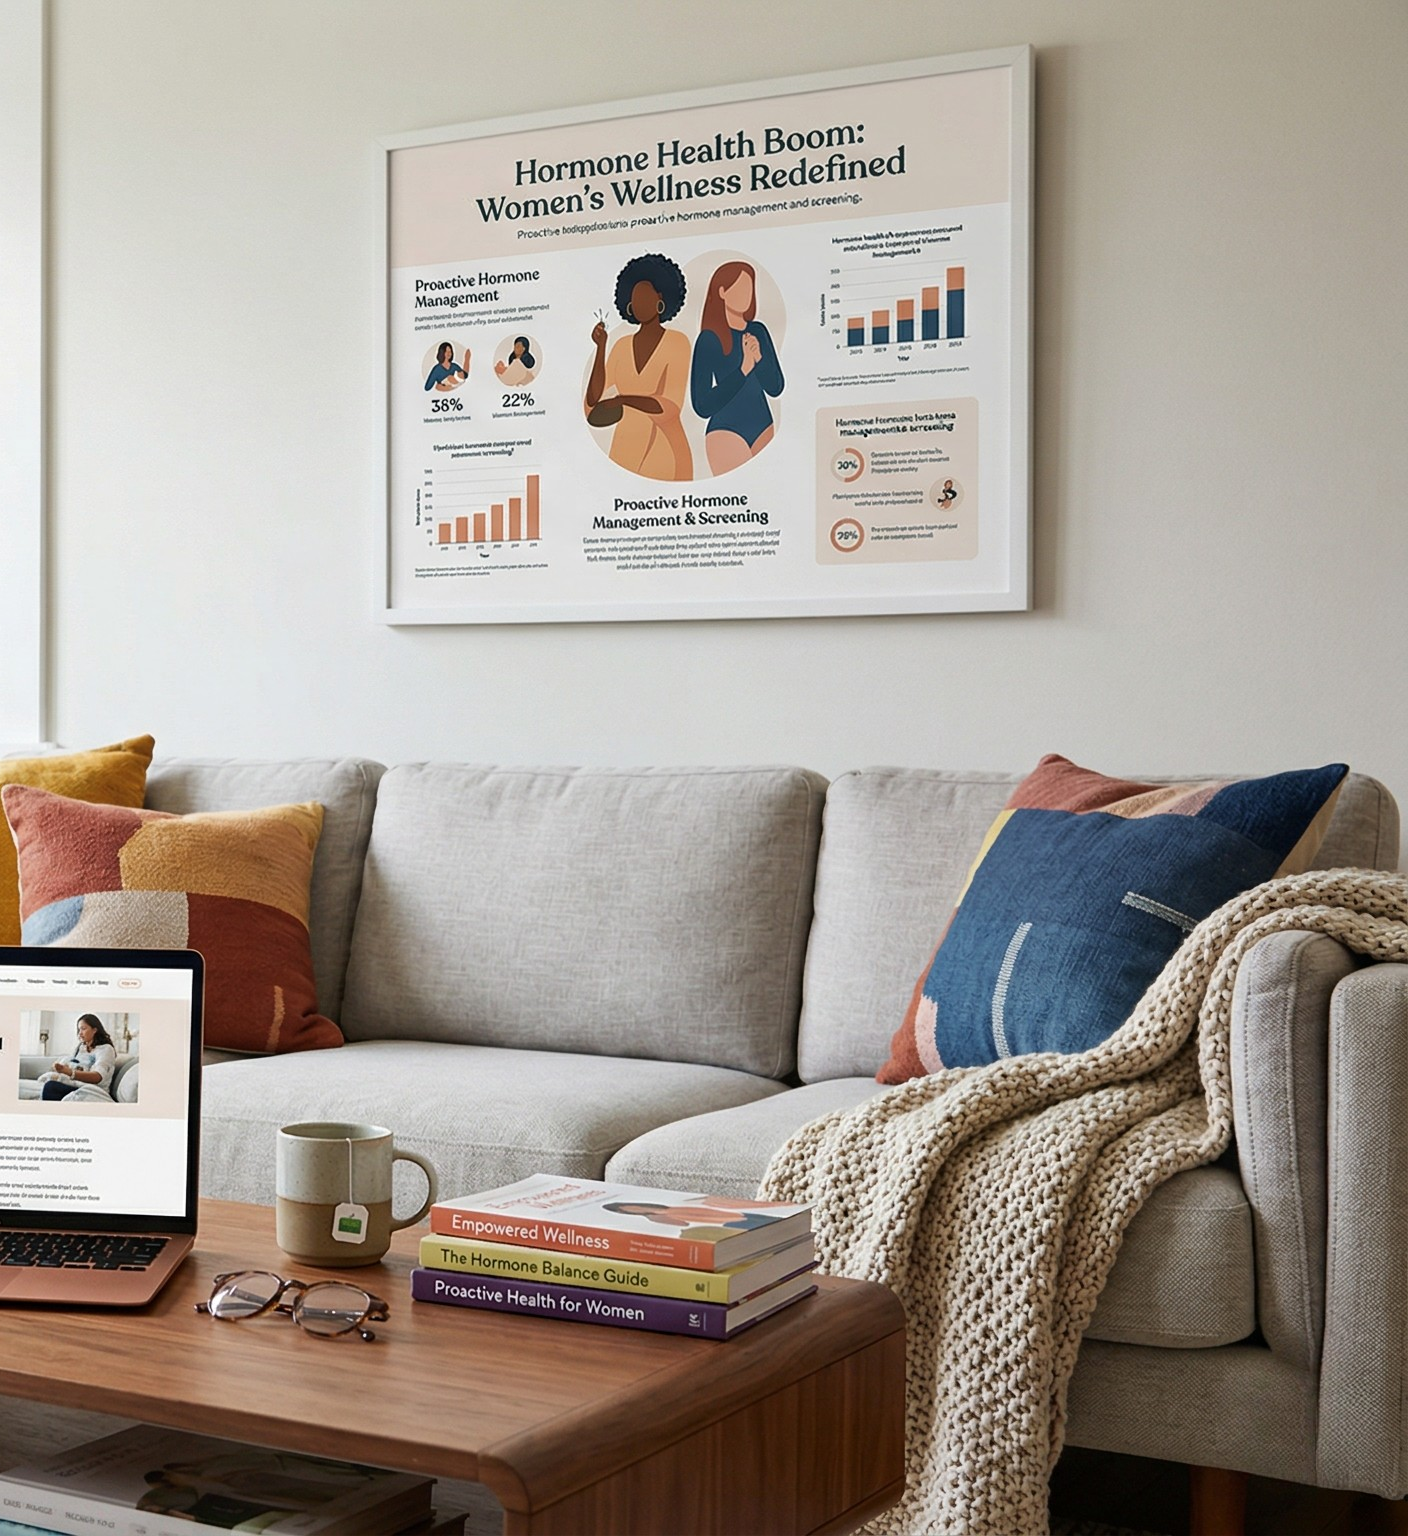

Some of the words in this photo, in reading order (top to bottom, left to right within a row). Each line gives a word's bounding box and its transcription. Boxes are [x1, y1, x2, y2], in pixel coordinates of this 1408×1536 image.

[515, 148, 649, 187] Hormone
[657, 131, 755, 169] Health
[764, 123, 865, 154] Boom:
[611, 172, 742, 205] Wellness
[750, 145, 907, 192] Redefined
[789, 198, 809, 210] and
[415, 275, 476, 292] Proactive
[478, 270, 540, 287] Hormone
[415, 290, 500, 309] Management
[431, 398, 464, 413] 38%
[502, 392, 535, 408] 22%
[614, 496, 679, 512] Proactive
[681, 494, 748, 509] Hormone
[592, 513, 682, 531] Management
[684, 512, 696, 525] &
[698, 509, 769, 525] Screening
[452, 1214, 539, 1240] Empowered
[542, 1225, 610, 1251] Wellness
[441, 1248, 467, 1266] The
[471, 1252, 538, 1274] Hormone
[542, 1262, 600, 1282] Balance
[604, 1269, 649, 1288] Guide
[434, 1280, 503, 1303] Proactive
[507, 1289, 556, 1310] Health
[560, 1296, 582, 1313] for
[586, 1298, 645, 1321] Women
